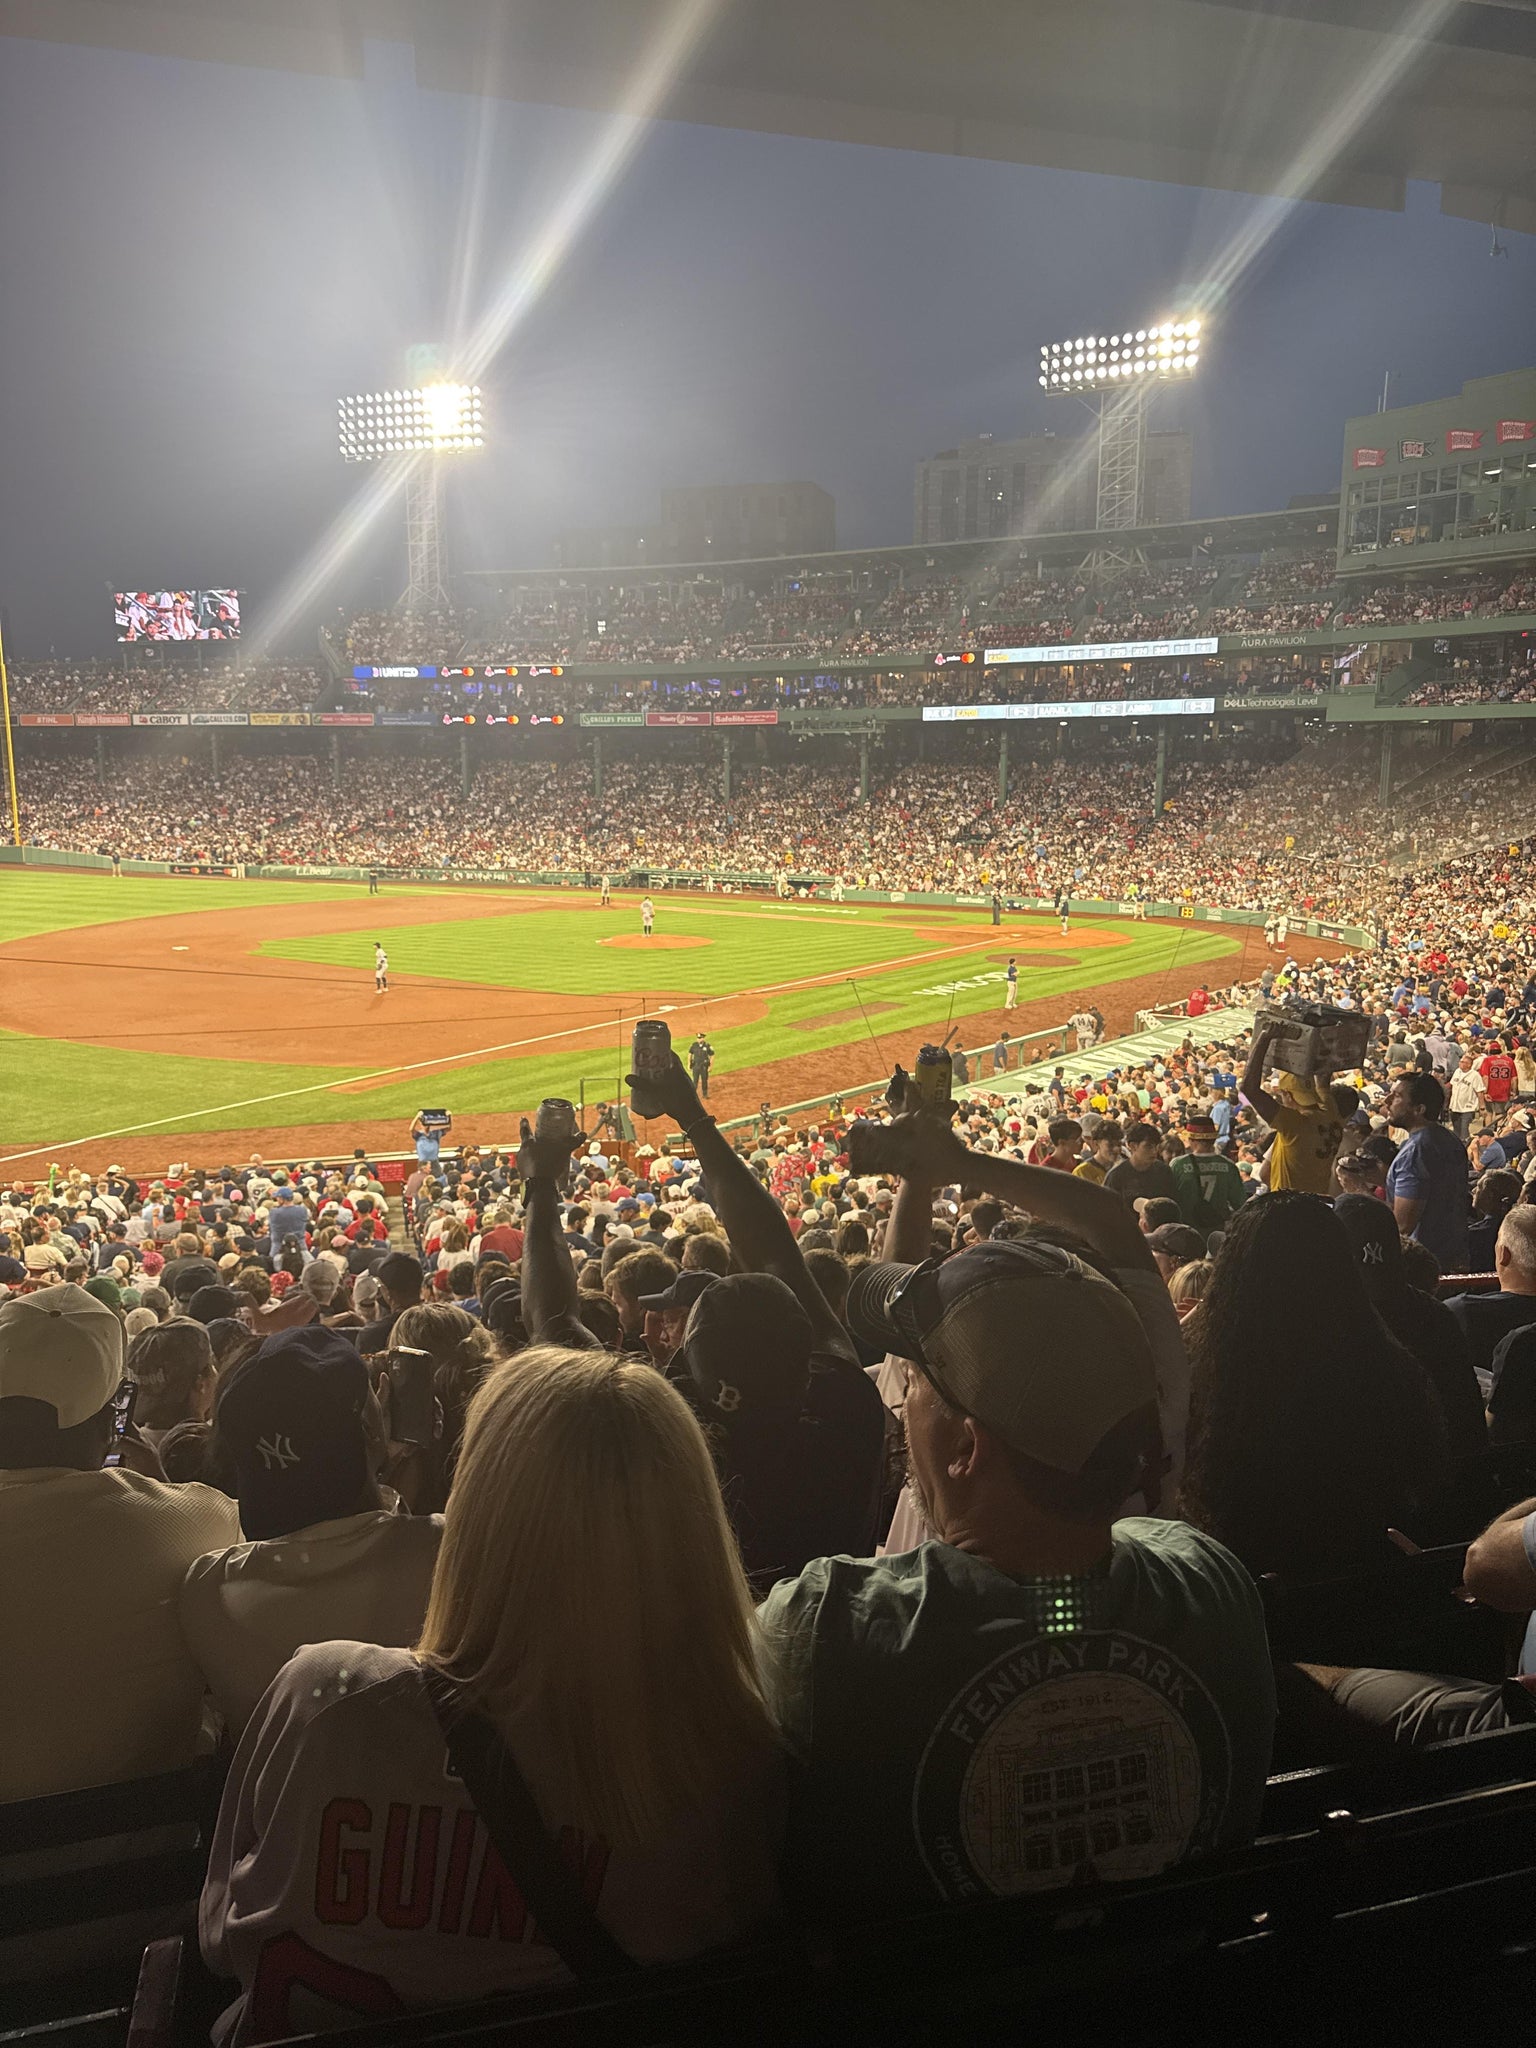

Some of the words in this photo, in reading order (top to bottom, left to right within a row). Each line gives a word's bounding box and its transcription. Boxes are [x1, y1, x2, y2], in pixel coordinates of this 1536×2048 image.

[1269, 636, 1307, 646] PAVILION
[1224, 698, 1247, 708] DELL
[1247, 698, 1296, 708] Technologies
[1297, 697, 1318, 705] Level
[1490, 1066, 1511, 1079] 33
[1200, 1175, 1217, 1202] 7
[1362, 1241, 1384, 1264] NY
[711, 1379, 743, 1412] B
[255, 1432, 301, 1470] NY
[949, 1640, 1089, 1746] FENWAY
[1107, 1639, 1199, 1711] PARK
